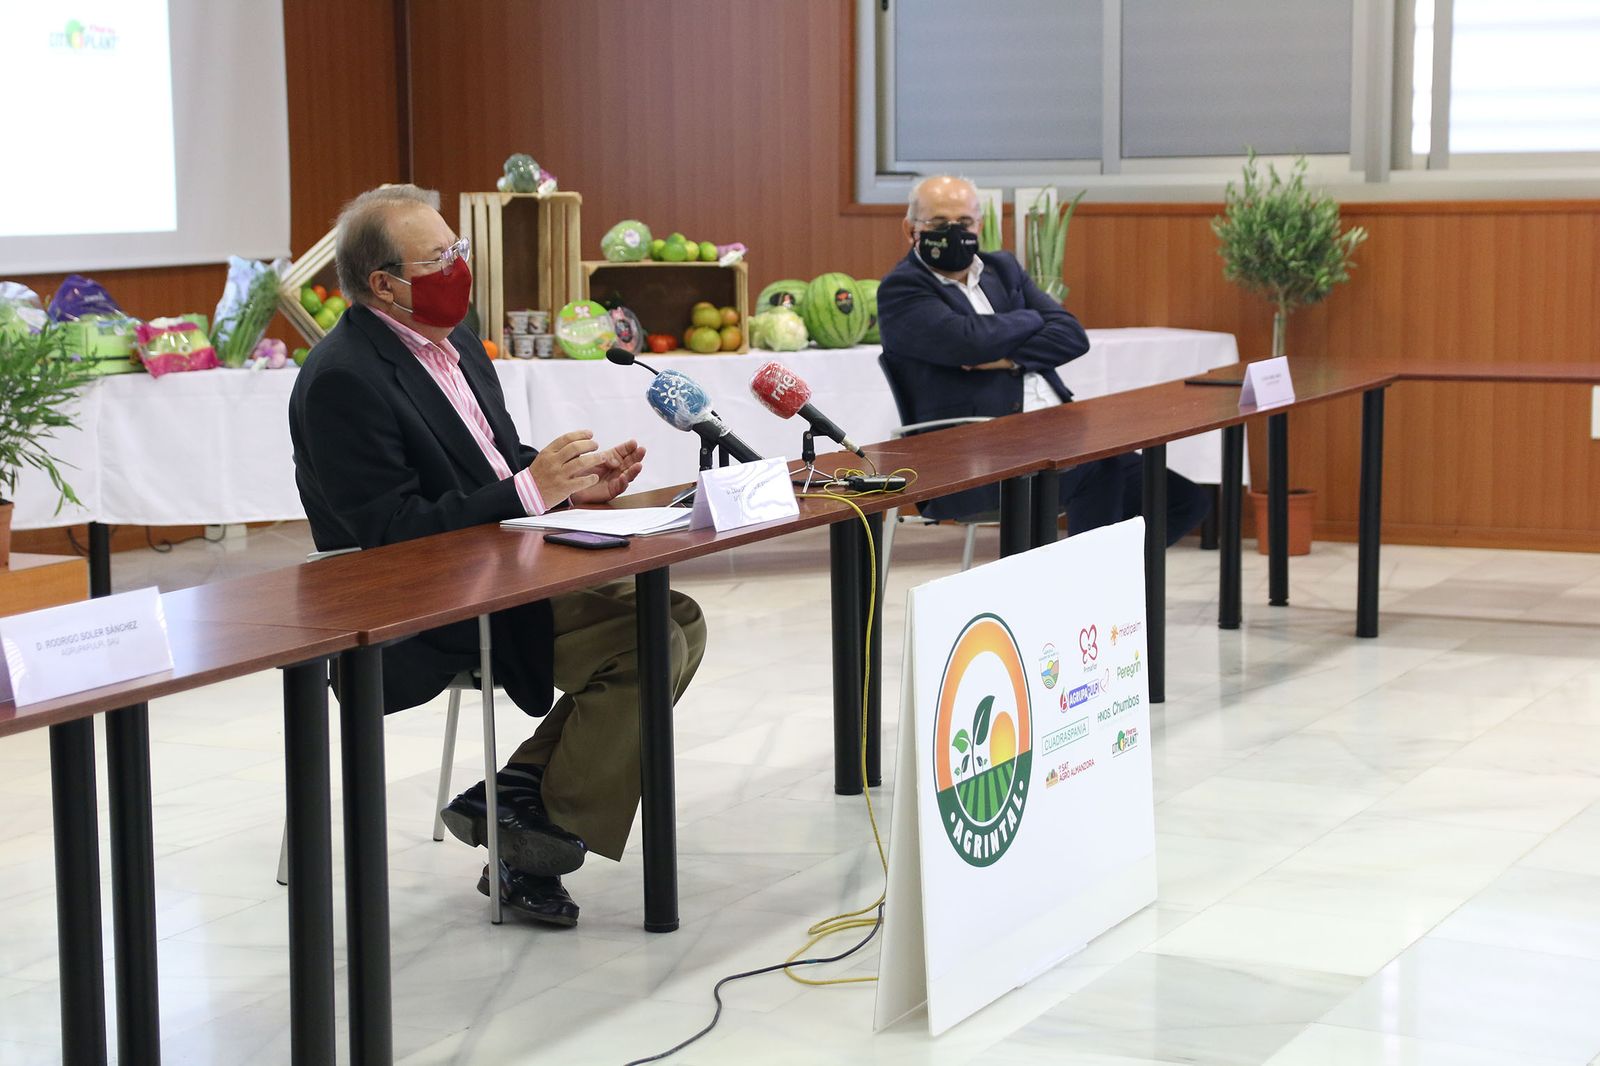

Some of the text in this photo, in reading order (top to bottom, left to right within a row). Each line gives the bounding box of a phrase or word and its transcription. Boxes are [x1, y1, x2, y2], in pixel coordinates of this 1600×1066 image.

[771, 373, 796, 401] rne
[45, 633, 79, 650] RODRIGO
[81, 627, 104, 641] SOLER
[1112, 694, 1140, 716] Chumbos
[1044, 722, 1087, 751] CUADRASPANIA
[952, 792, 1023, 859] AGRINTAL
